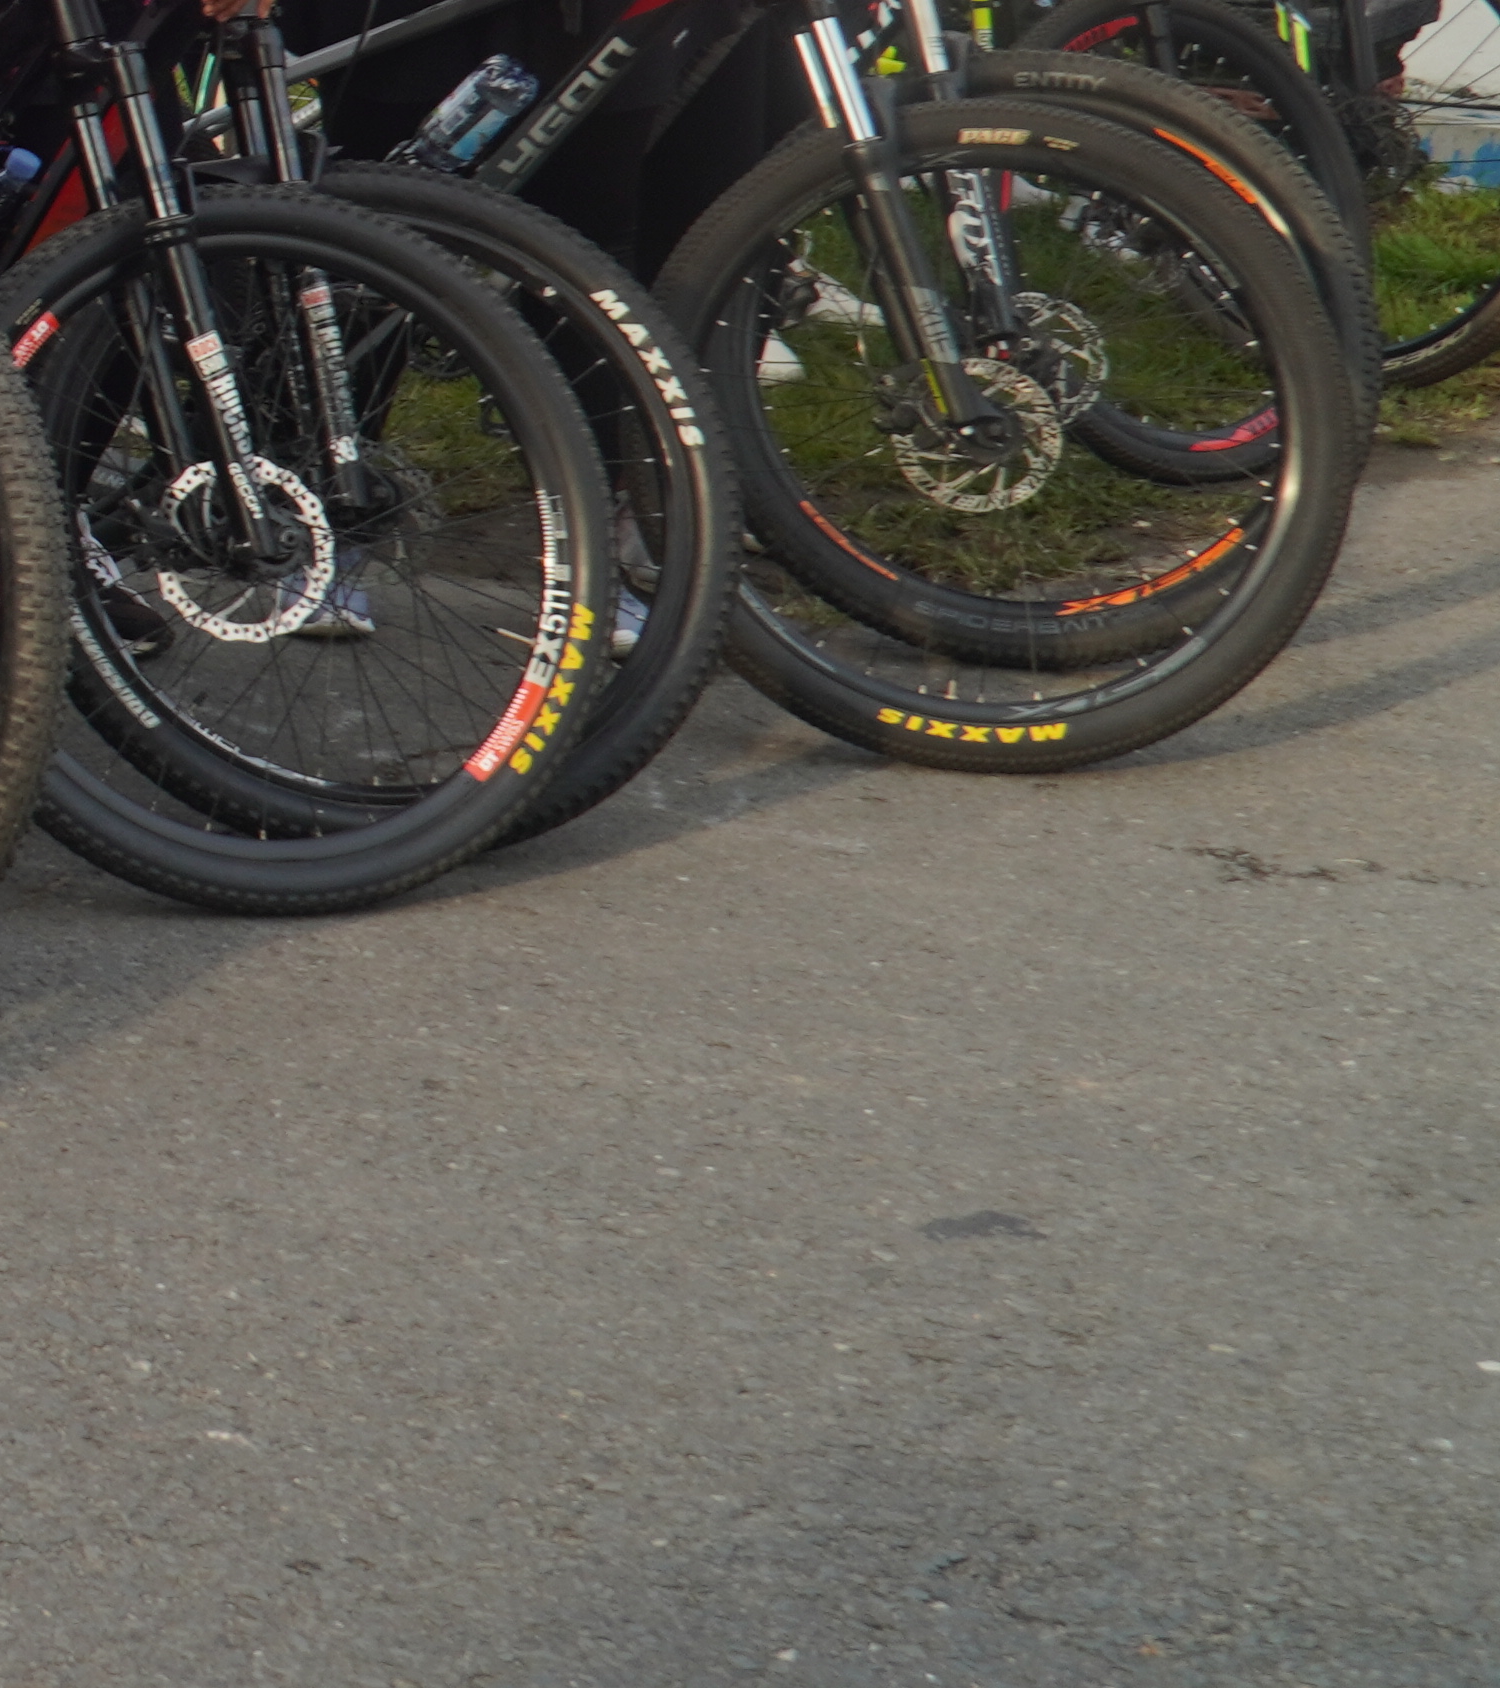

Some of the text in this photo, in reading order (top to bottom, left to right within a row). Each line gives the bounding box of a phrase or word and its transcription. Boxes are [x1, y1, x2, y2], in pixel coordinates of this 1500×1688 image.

[588, 288, 706, 449] MAXXIS
[508, 602, 596, 774] MAXXIS
[524, 582, 571, 687] EX511
[877, 707, 1069, 744] MAXXIS
